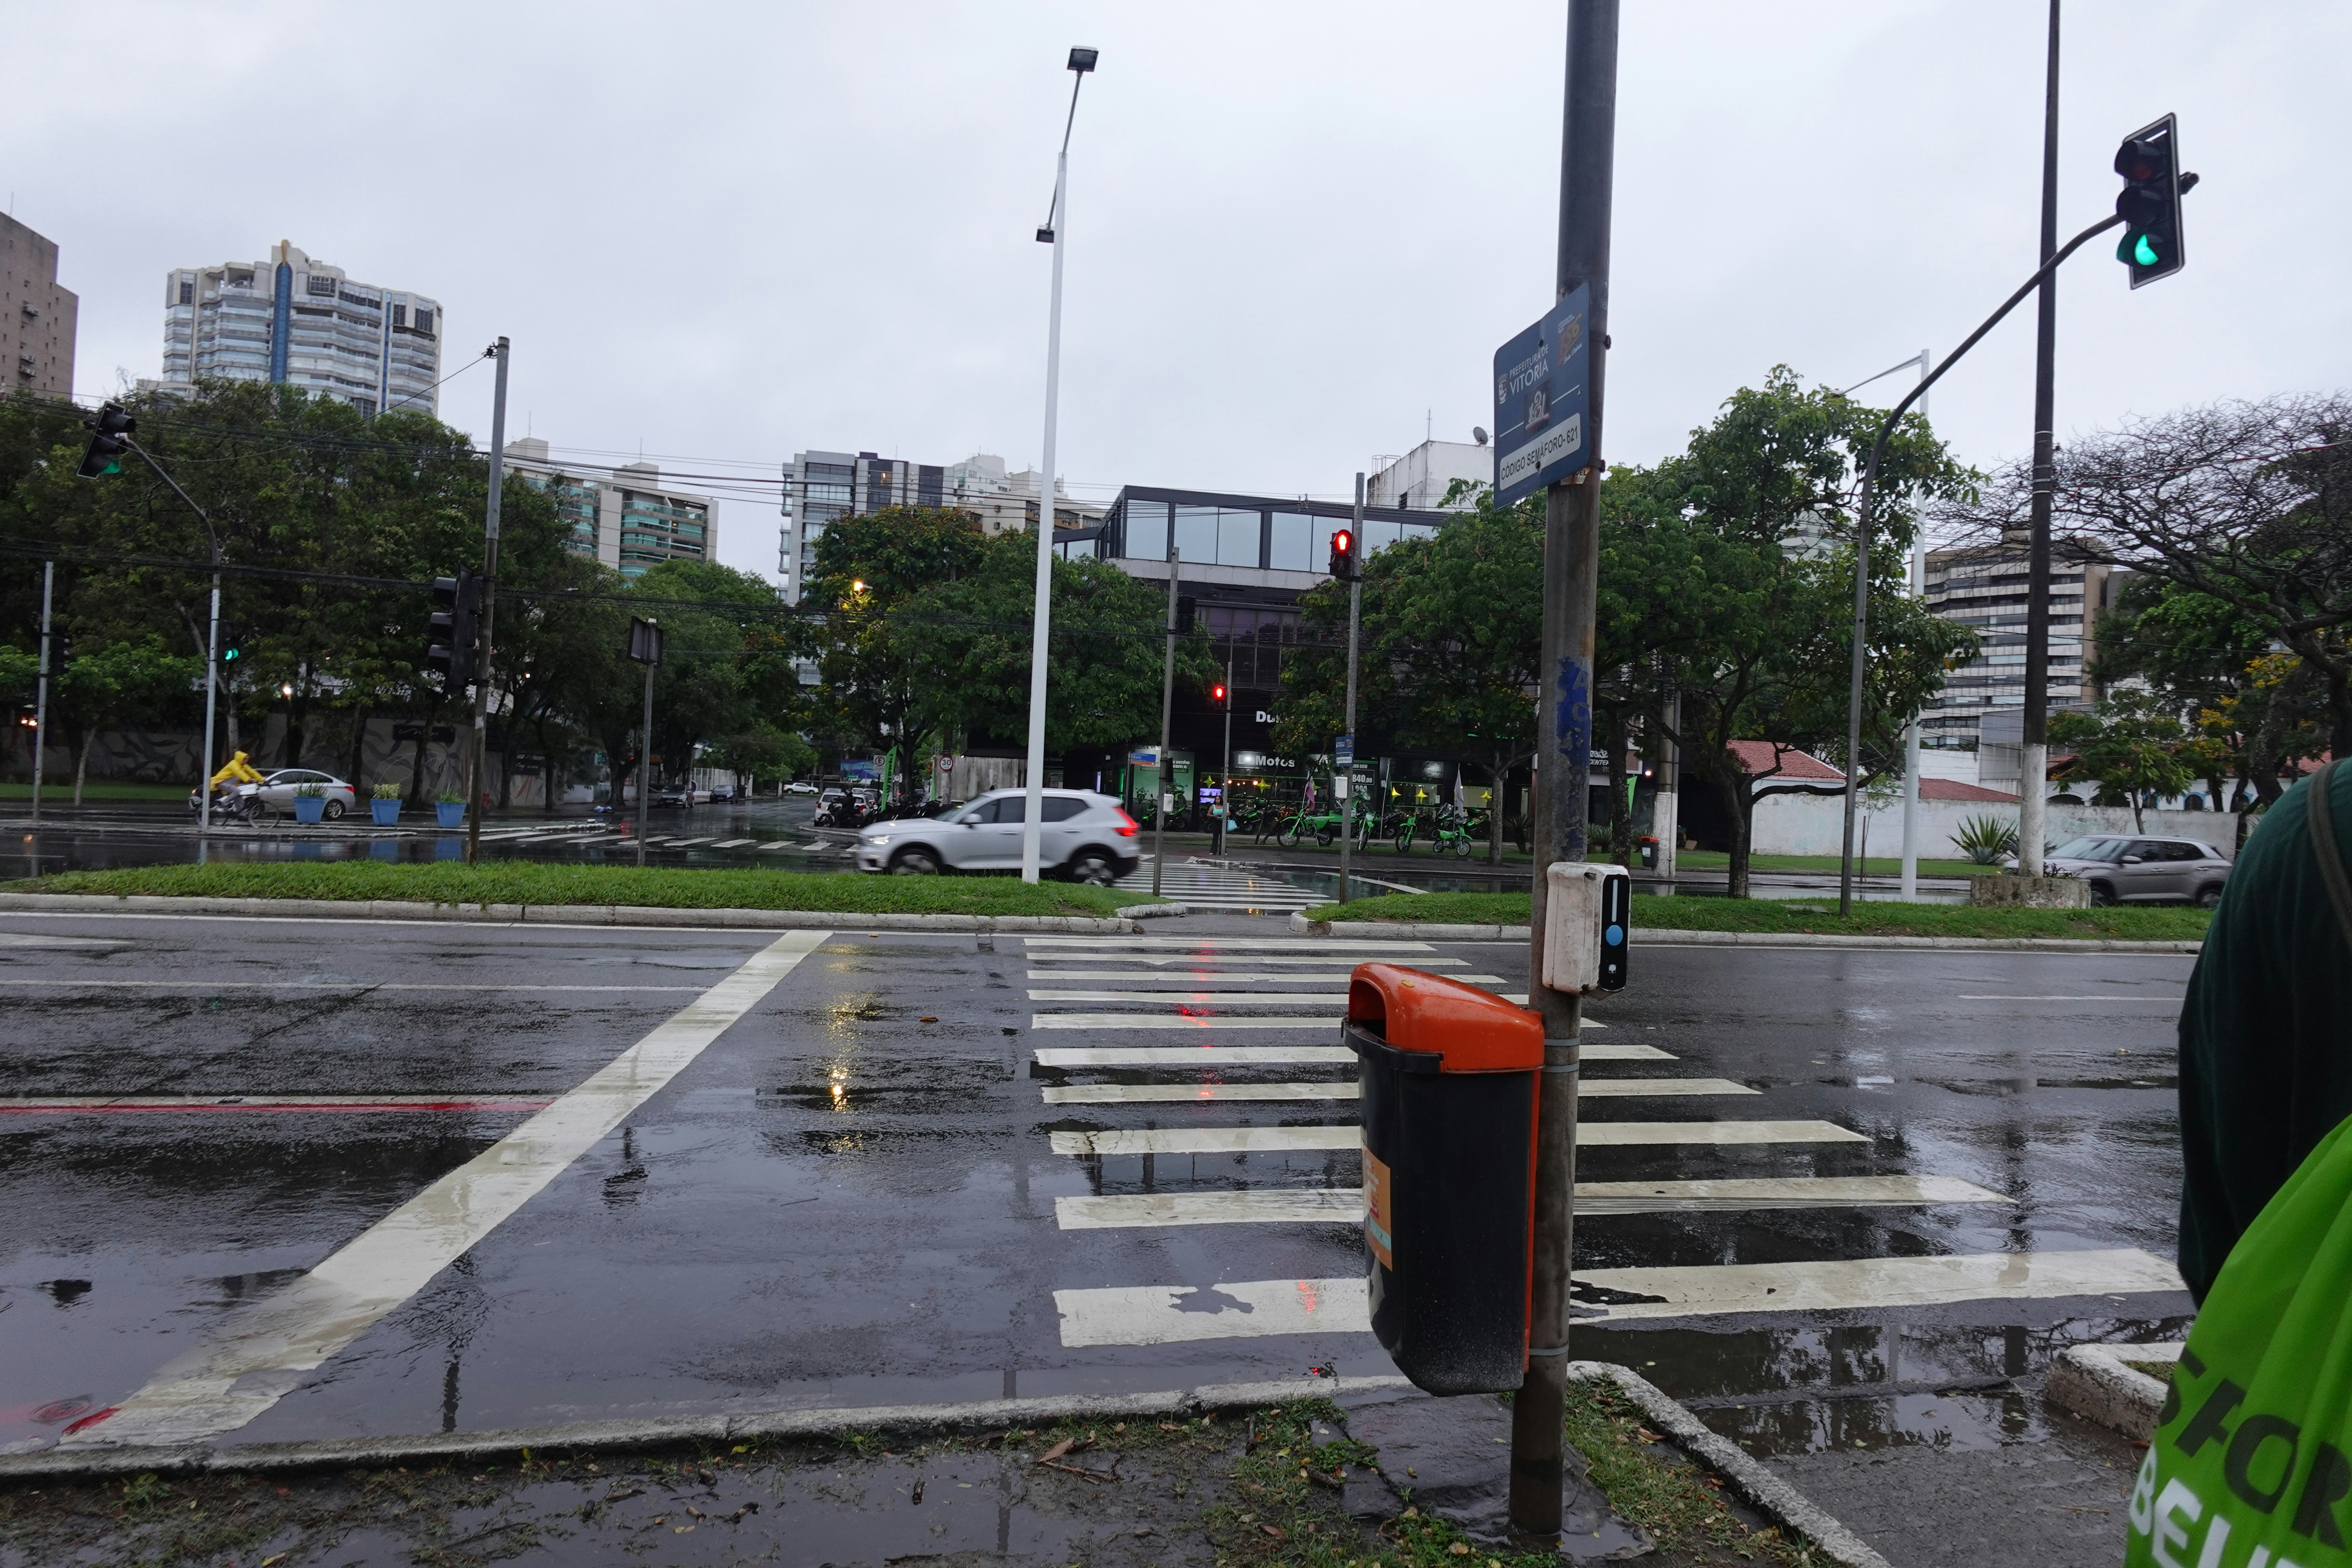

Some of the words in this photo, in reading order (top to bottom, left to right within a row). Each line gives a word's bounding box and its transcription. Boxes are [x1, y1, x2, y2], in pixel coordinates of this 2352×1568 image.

[1509, 352, 1541, 379] PREFEITURA
[1541, 343, 1549, 357] DE
[1509, 358, 1549, 395] VITÓRIA
[1501, 456, 1526, 481] CÓDIGO
[1526, 434, 1565, 467] SEMÁFORO-
[1566, 425, 1578, 444] 621
